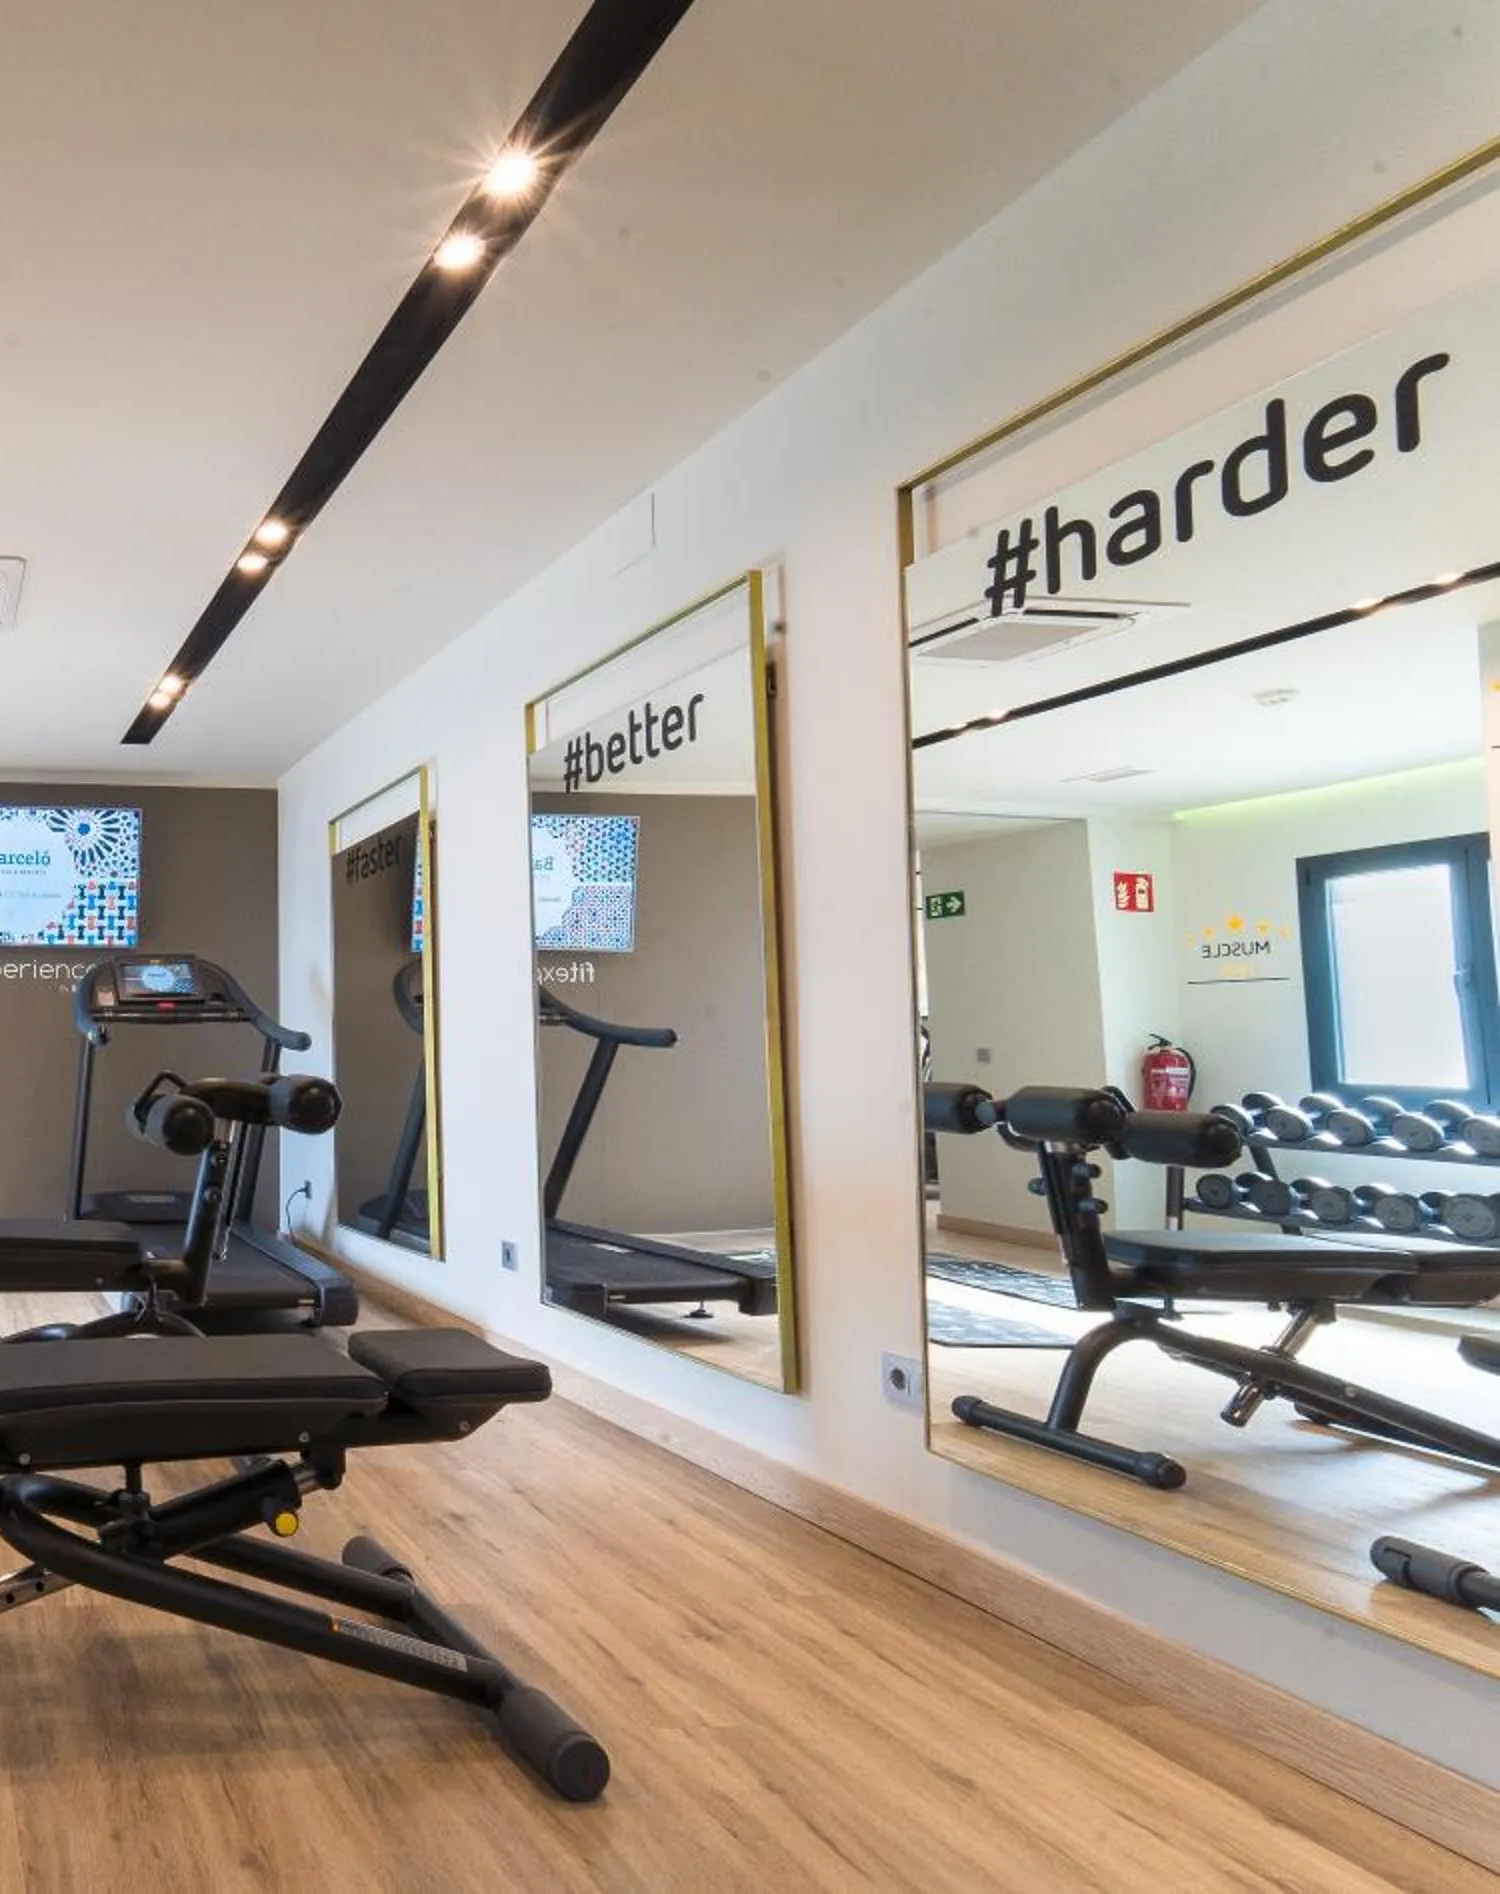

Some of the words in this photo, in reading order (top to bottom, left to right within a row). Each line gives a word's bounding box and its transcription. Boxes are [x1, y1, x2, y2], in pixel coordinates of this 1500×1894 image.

[983, 352, 1451, 616] #harder
[564, 693, 705, 794] #better
[346, 833, 402, 886] #faster
